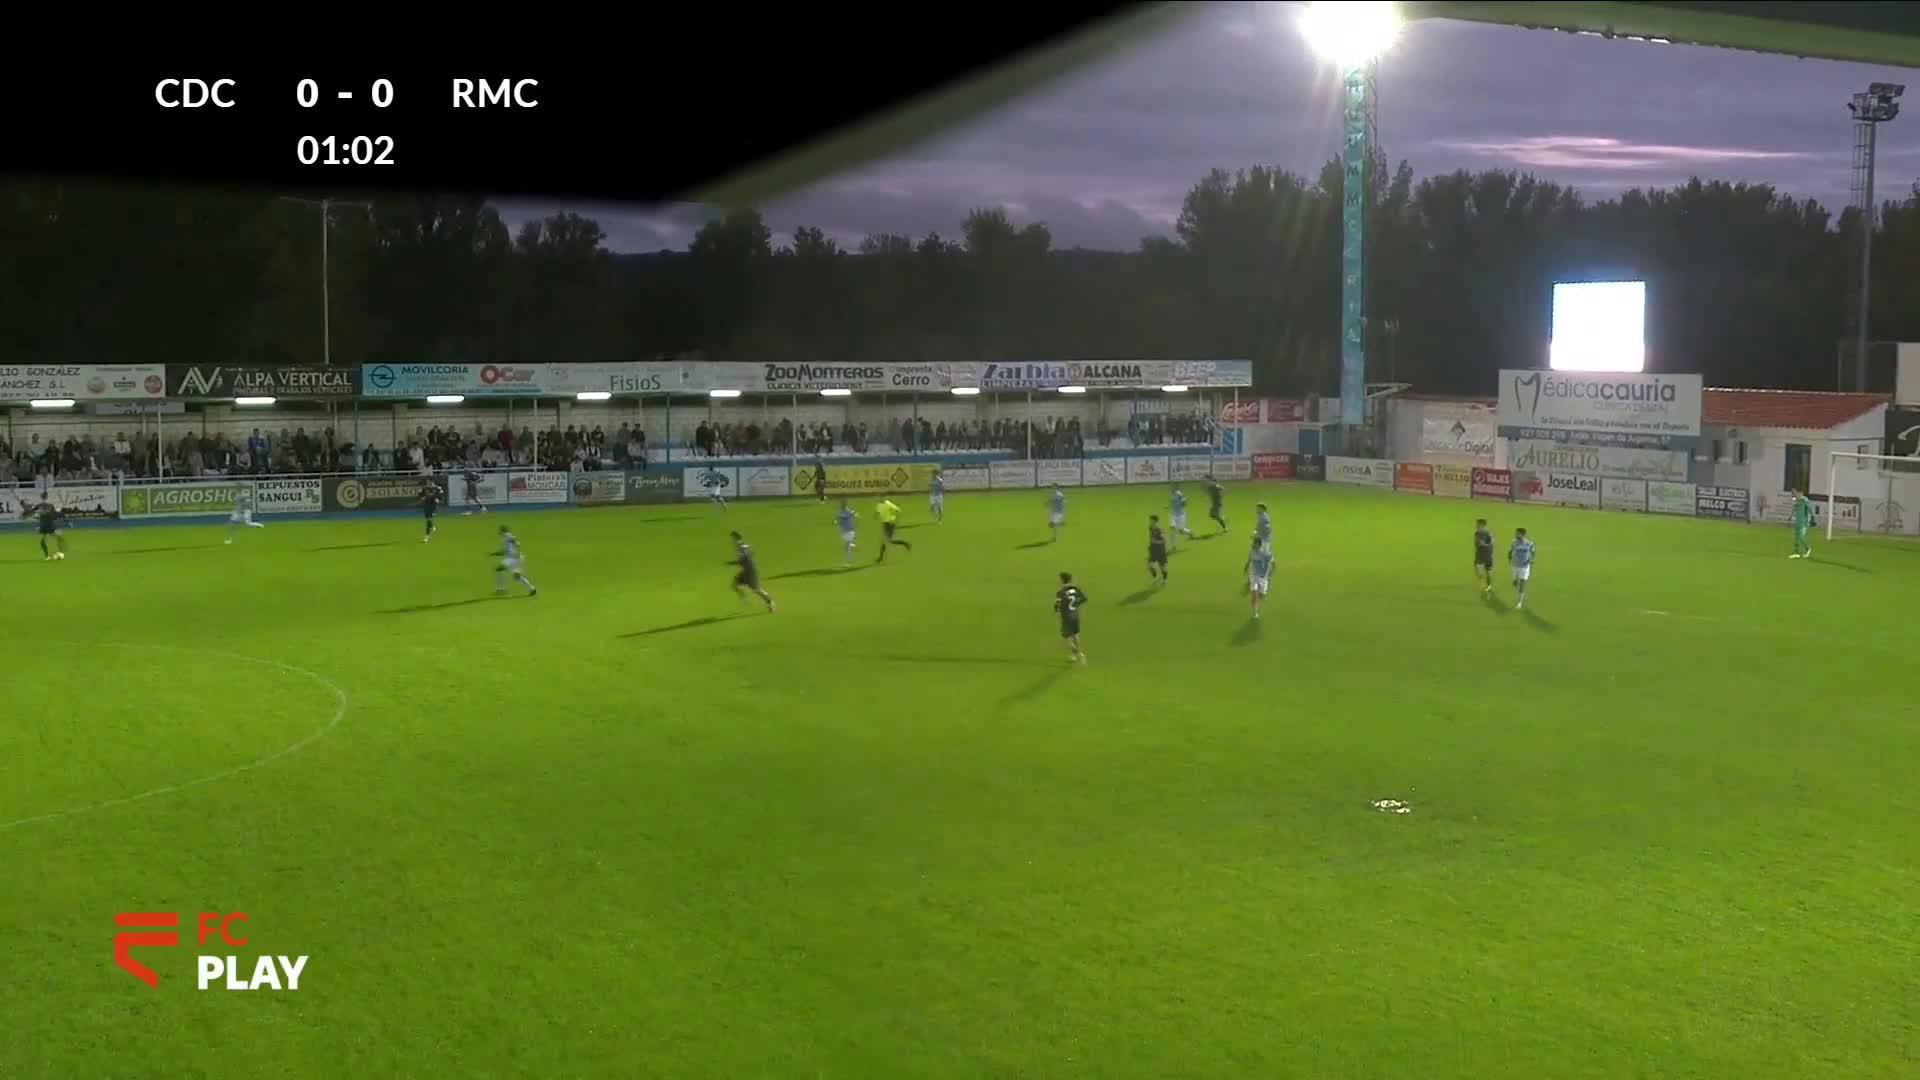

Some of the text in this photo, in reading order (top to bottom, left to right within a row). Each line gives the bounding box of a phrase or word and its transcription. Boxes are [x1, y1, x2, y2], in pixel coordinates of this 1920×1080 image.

[401, 365, 469, 375] MOVILCORIA
[1083, 364, 1142, 379] ALCANA
[234, 371, 353, 387] ALPA VERTICAL
[892, 373, 931, 387] Cerro
[1516, 444, 1600, 472] AURELIO
[257, 480, 320, 490] REPUESTOS
[1547, 475, 1598, 492] JoseLeal
[153, 488, 250, 506] AGROSHOP
[257, 492, 302, 503] SANGUI
[1067, 595, 1077, 611] 2
